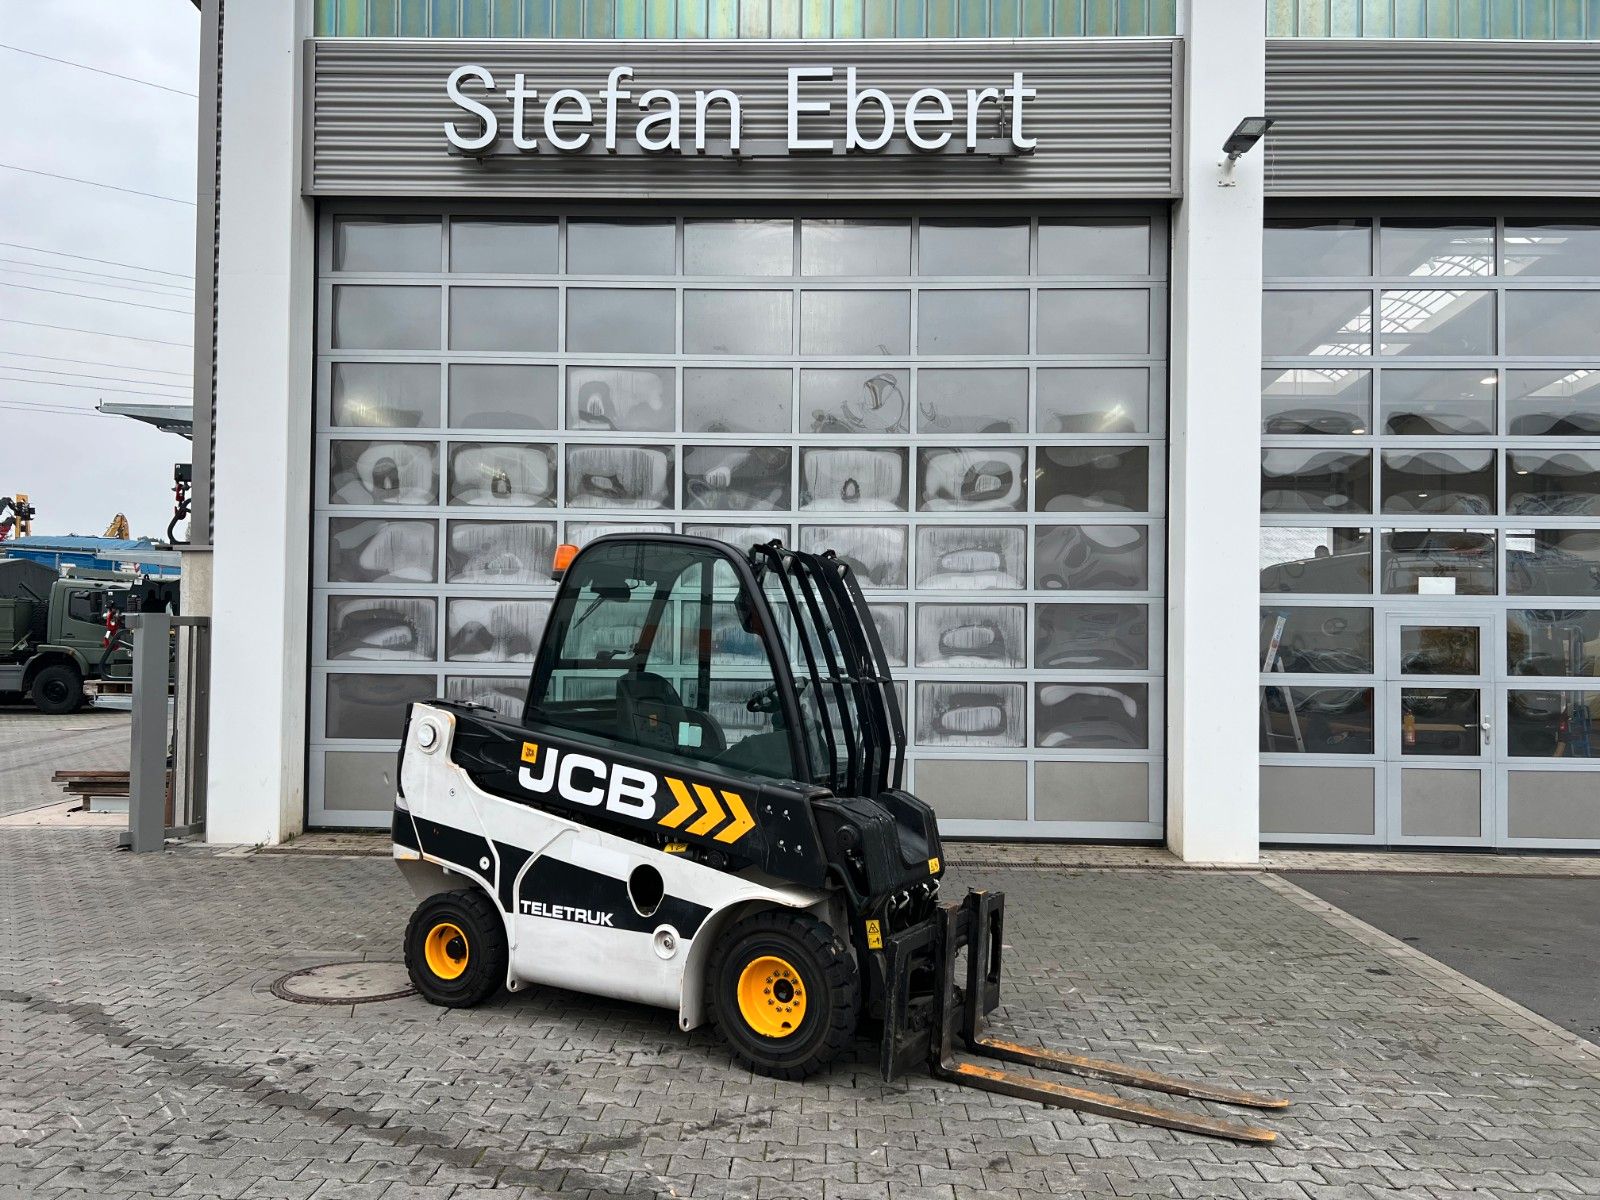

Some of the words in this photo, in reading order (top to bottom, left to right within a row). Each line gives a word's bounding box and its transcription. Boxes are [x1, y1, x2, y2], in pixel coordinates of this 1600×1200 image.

[444, 65, 741, 152] Stefan
[787, 66, 1037, 152] Ebert
[518, 747, 658, 820] JCB
[520, 900, 614, 927] TELETRUK
